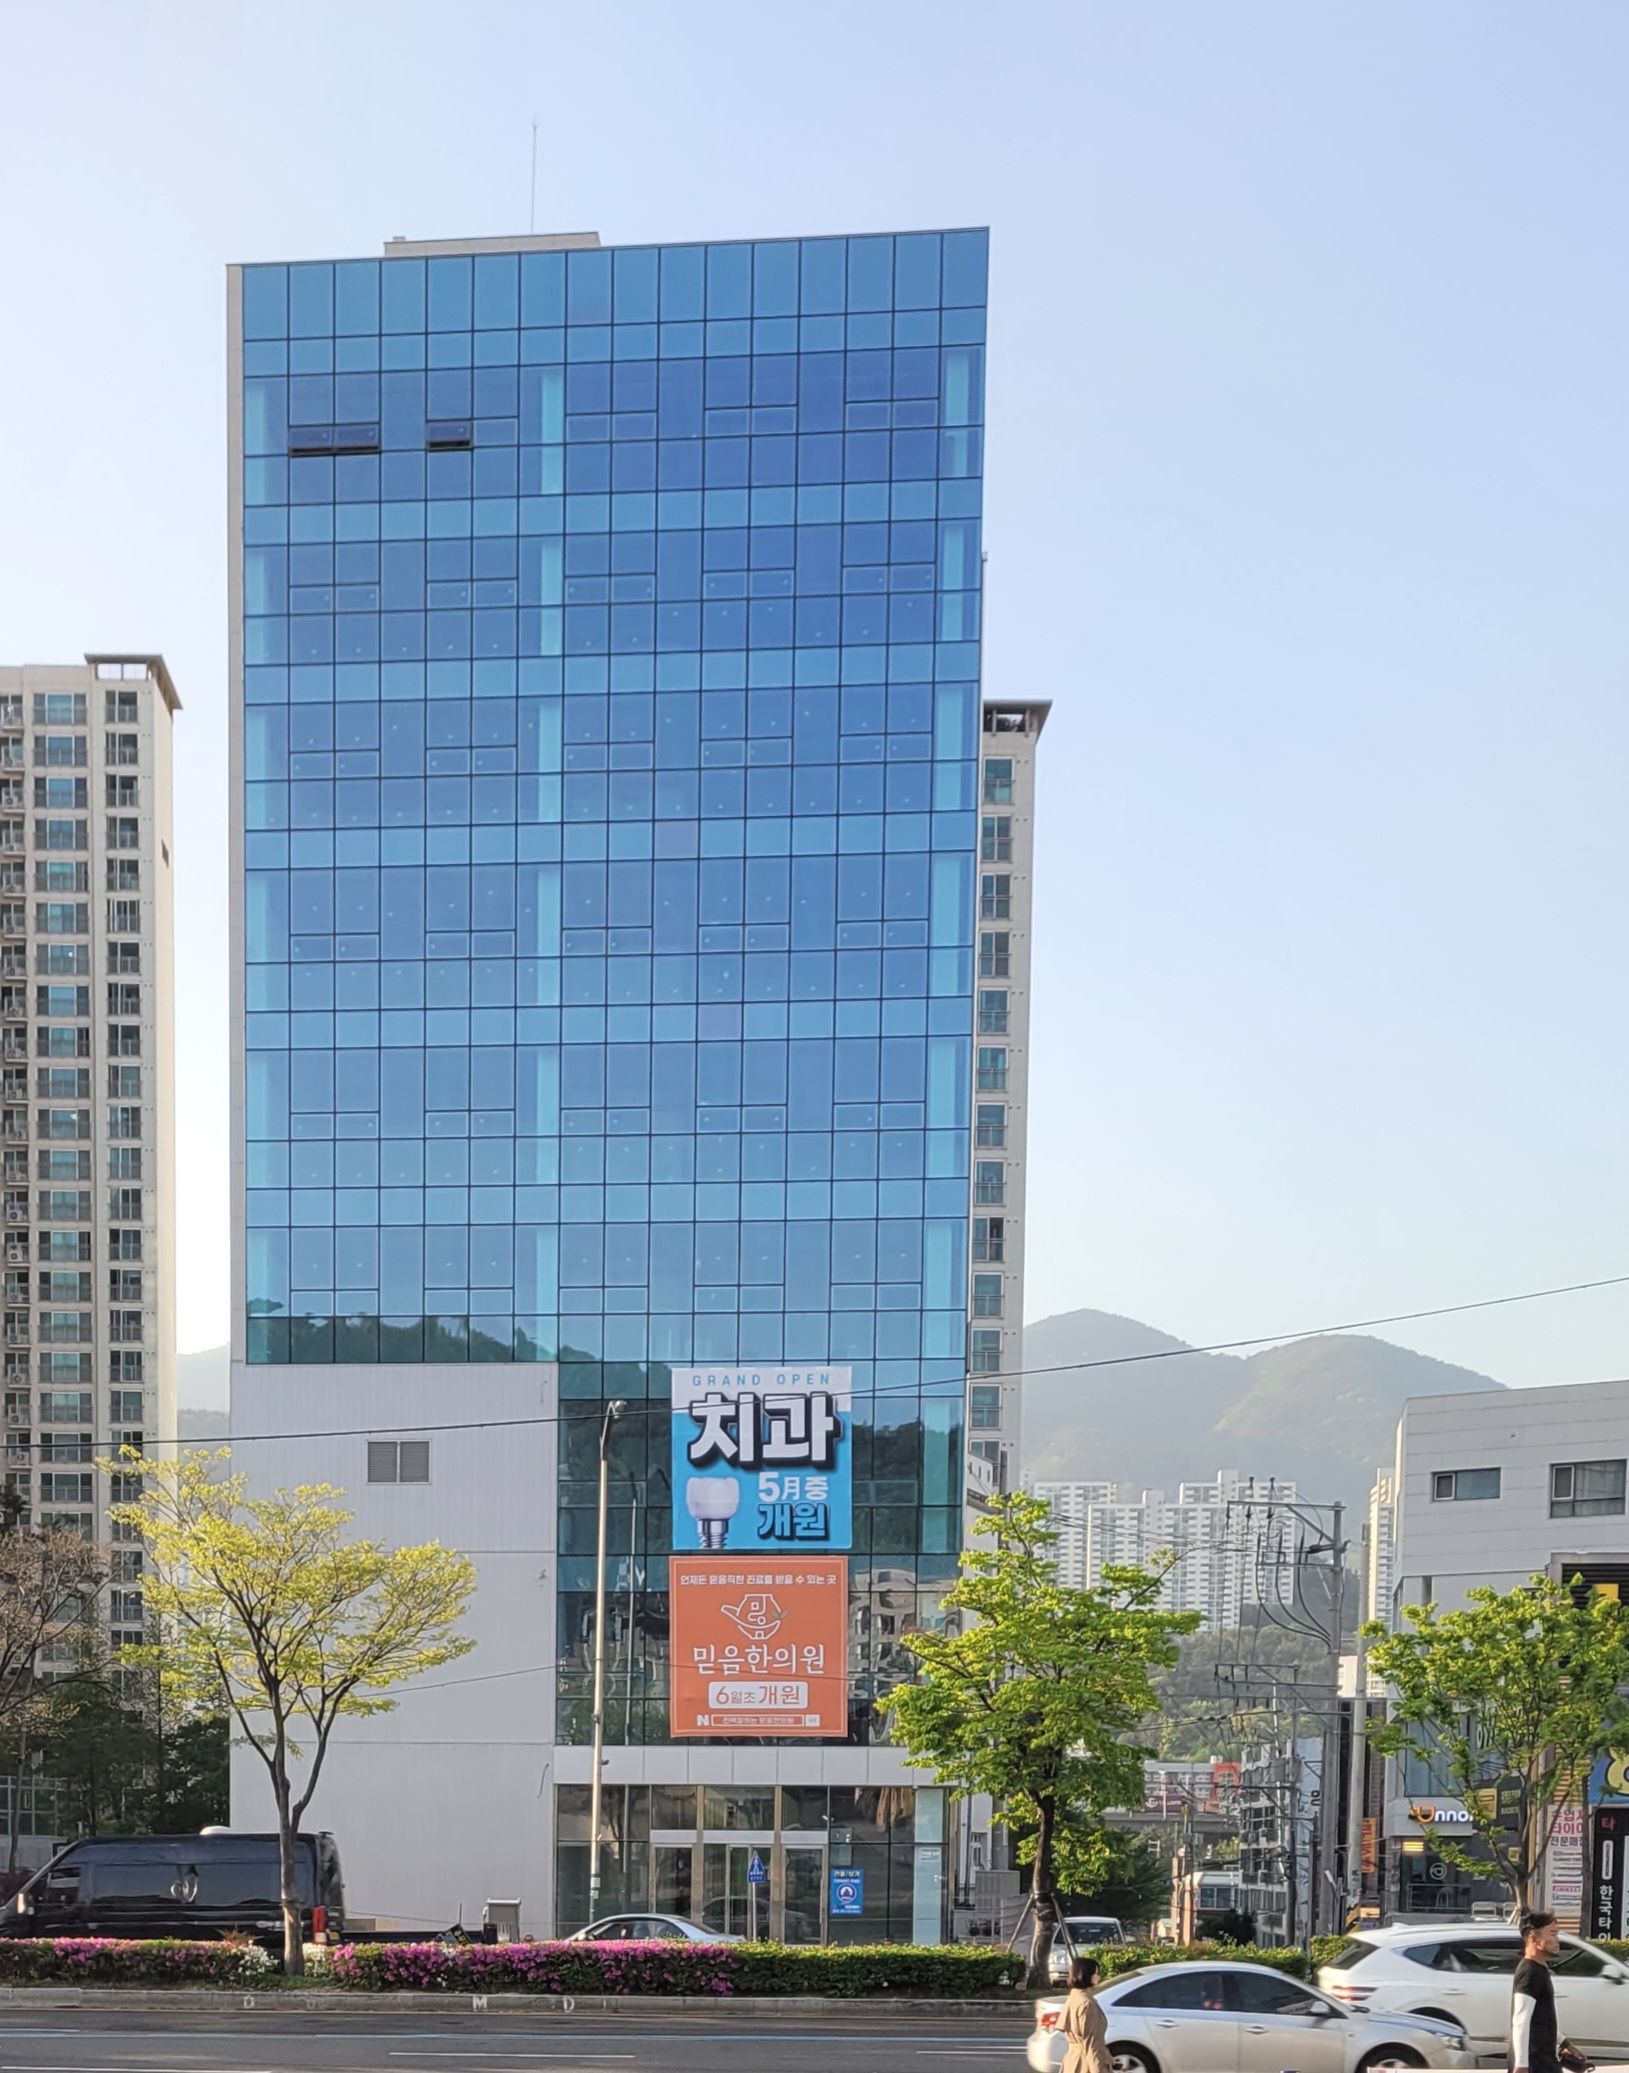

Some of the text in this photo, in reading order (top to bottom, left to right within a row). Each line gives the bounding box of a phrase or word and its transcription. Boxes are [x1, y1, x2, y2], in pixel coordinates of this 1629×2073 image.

[692, 1373, 830, 1386] GRAND OPEN
[688, 1391, 839, 1468] 치과
[757, 1503, 830, 1539] 개원
[693, 1643, 825, 1676] 믿음한의원
